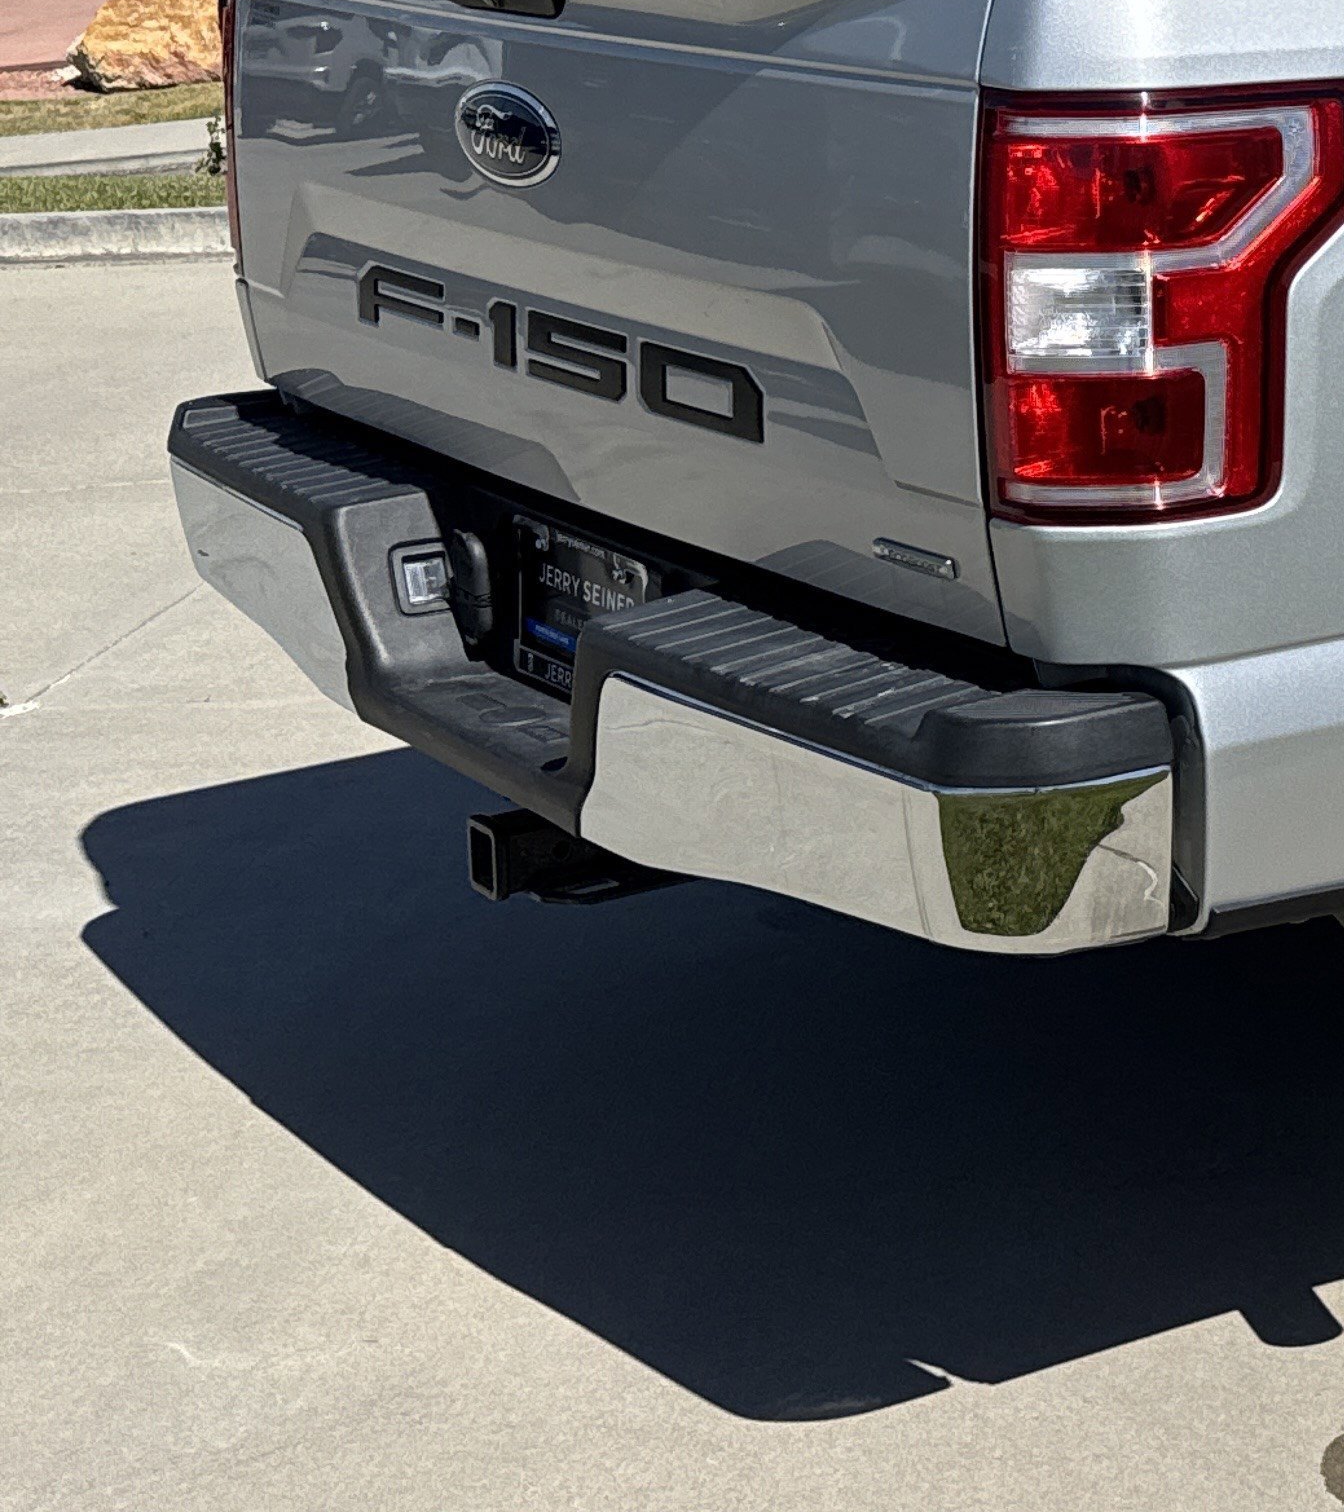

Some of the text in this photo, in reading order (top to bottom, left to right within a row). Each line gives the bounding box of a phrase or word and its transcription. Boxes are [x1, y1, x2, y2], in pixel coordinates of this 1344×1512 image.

[470, 104, 526, 164] Ford
[357, 261, 766, 445] F-150
[539, 563, 581, 598] JERRY
[544, 663, 573, 687] JERR
